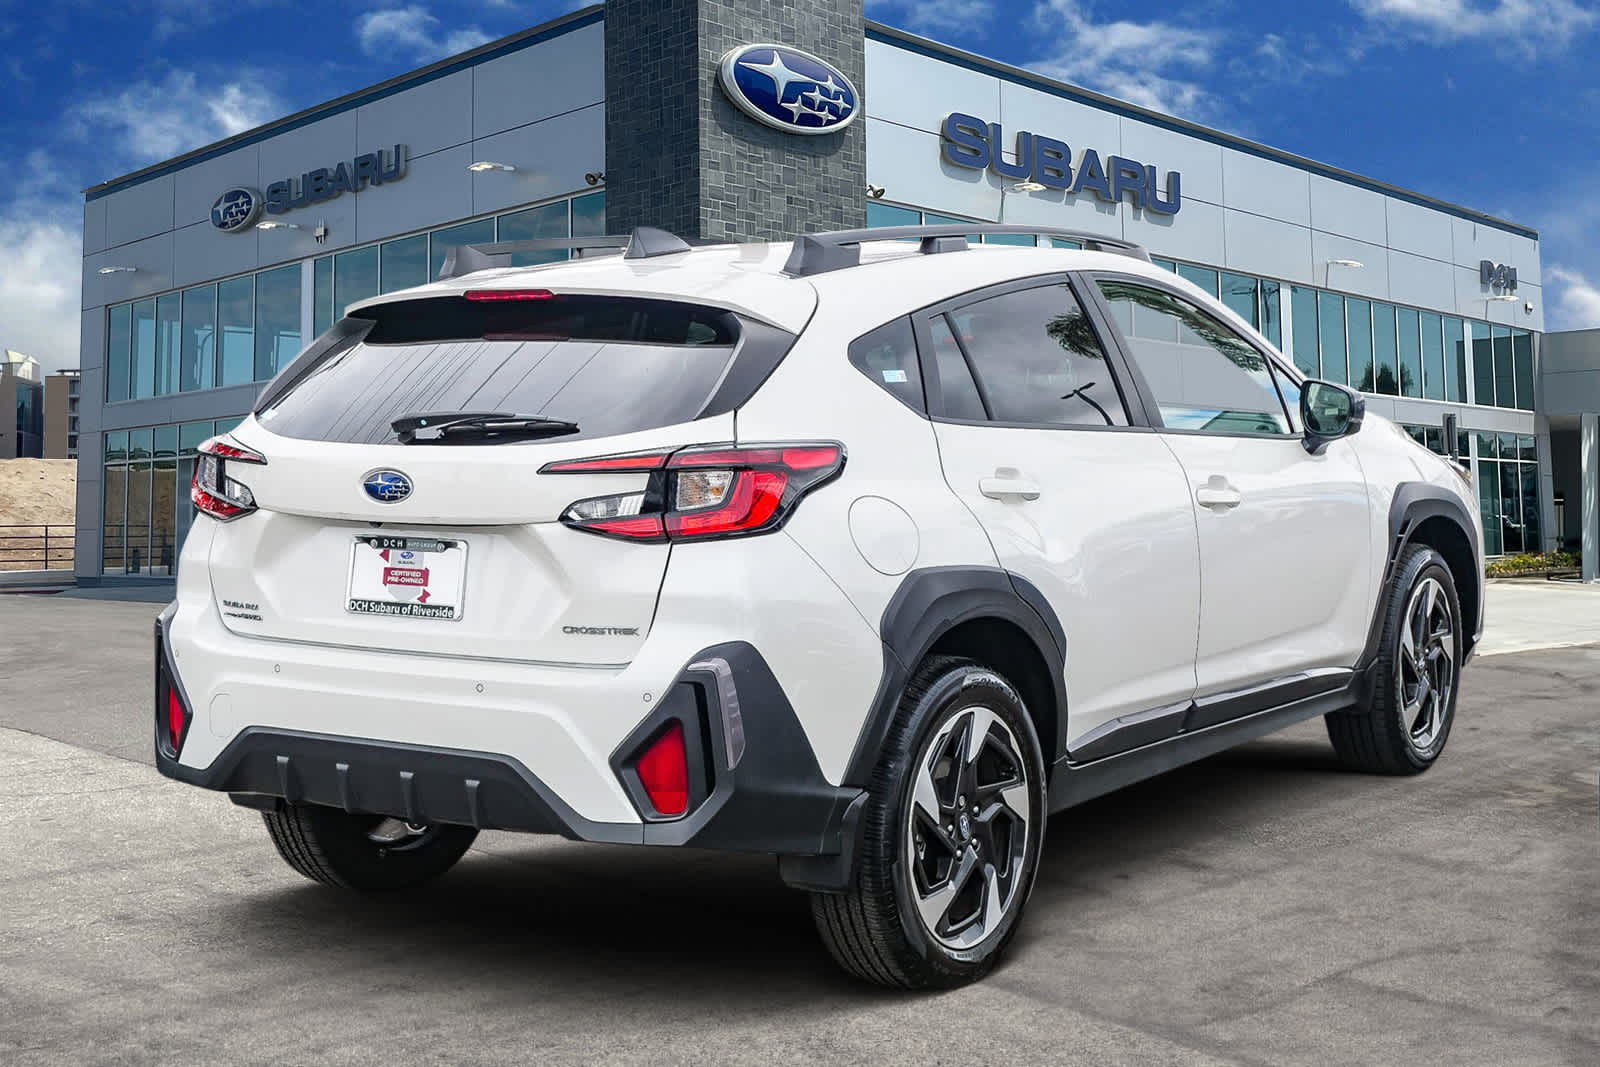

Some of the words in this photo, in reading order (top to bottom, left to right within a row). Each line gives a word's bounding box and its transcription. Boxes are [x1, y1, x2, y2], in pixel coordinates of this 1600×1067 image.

[941, 112, 1181, 215] SUBARU
[266, 143, 407, 215] SUBARU
[383, 539, 403, 547] DCH
[350, 600, 368, 611] DCH
[369, 603, 400, 614] Subaru
[401, 605, 411, 615] of
[412, 606, 453, 618] Riverside
[562, 626, 640, 636] CROSSTREK
